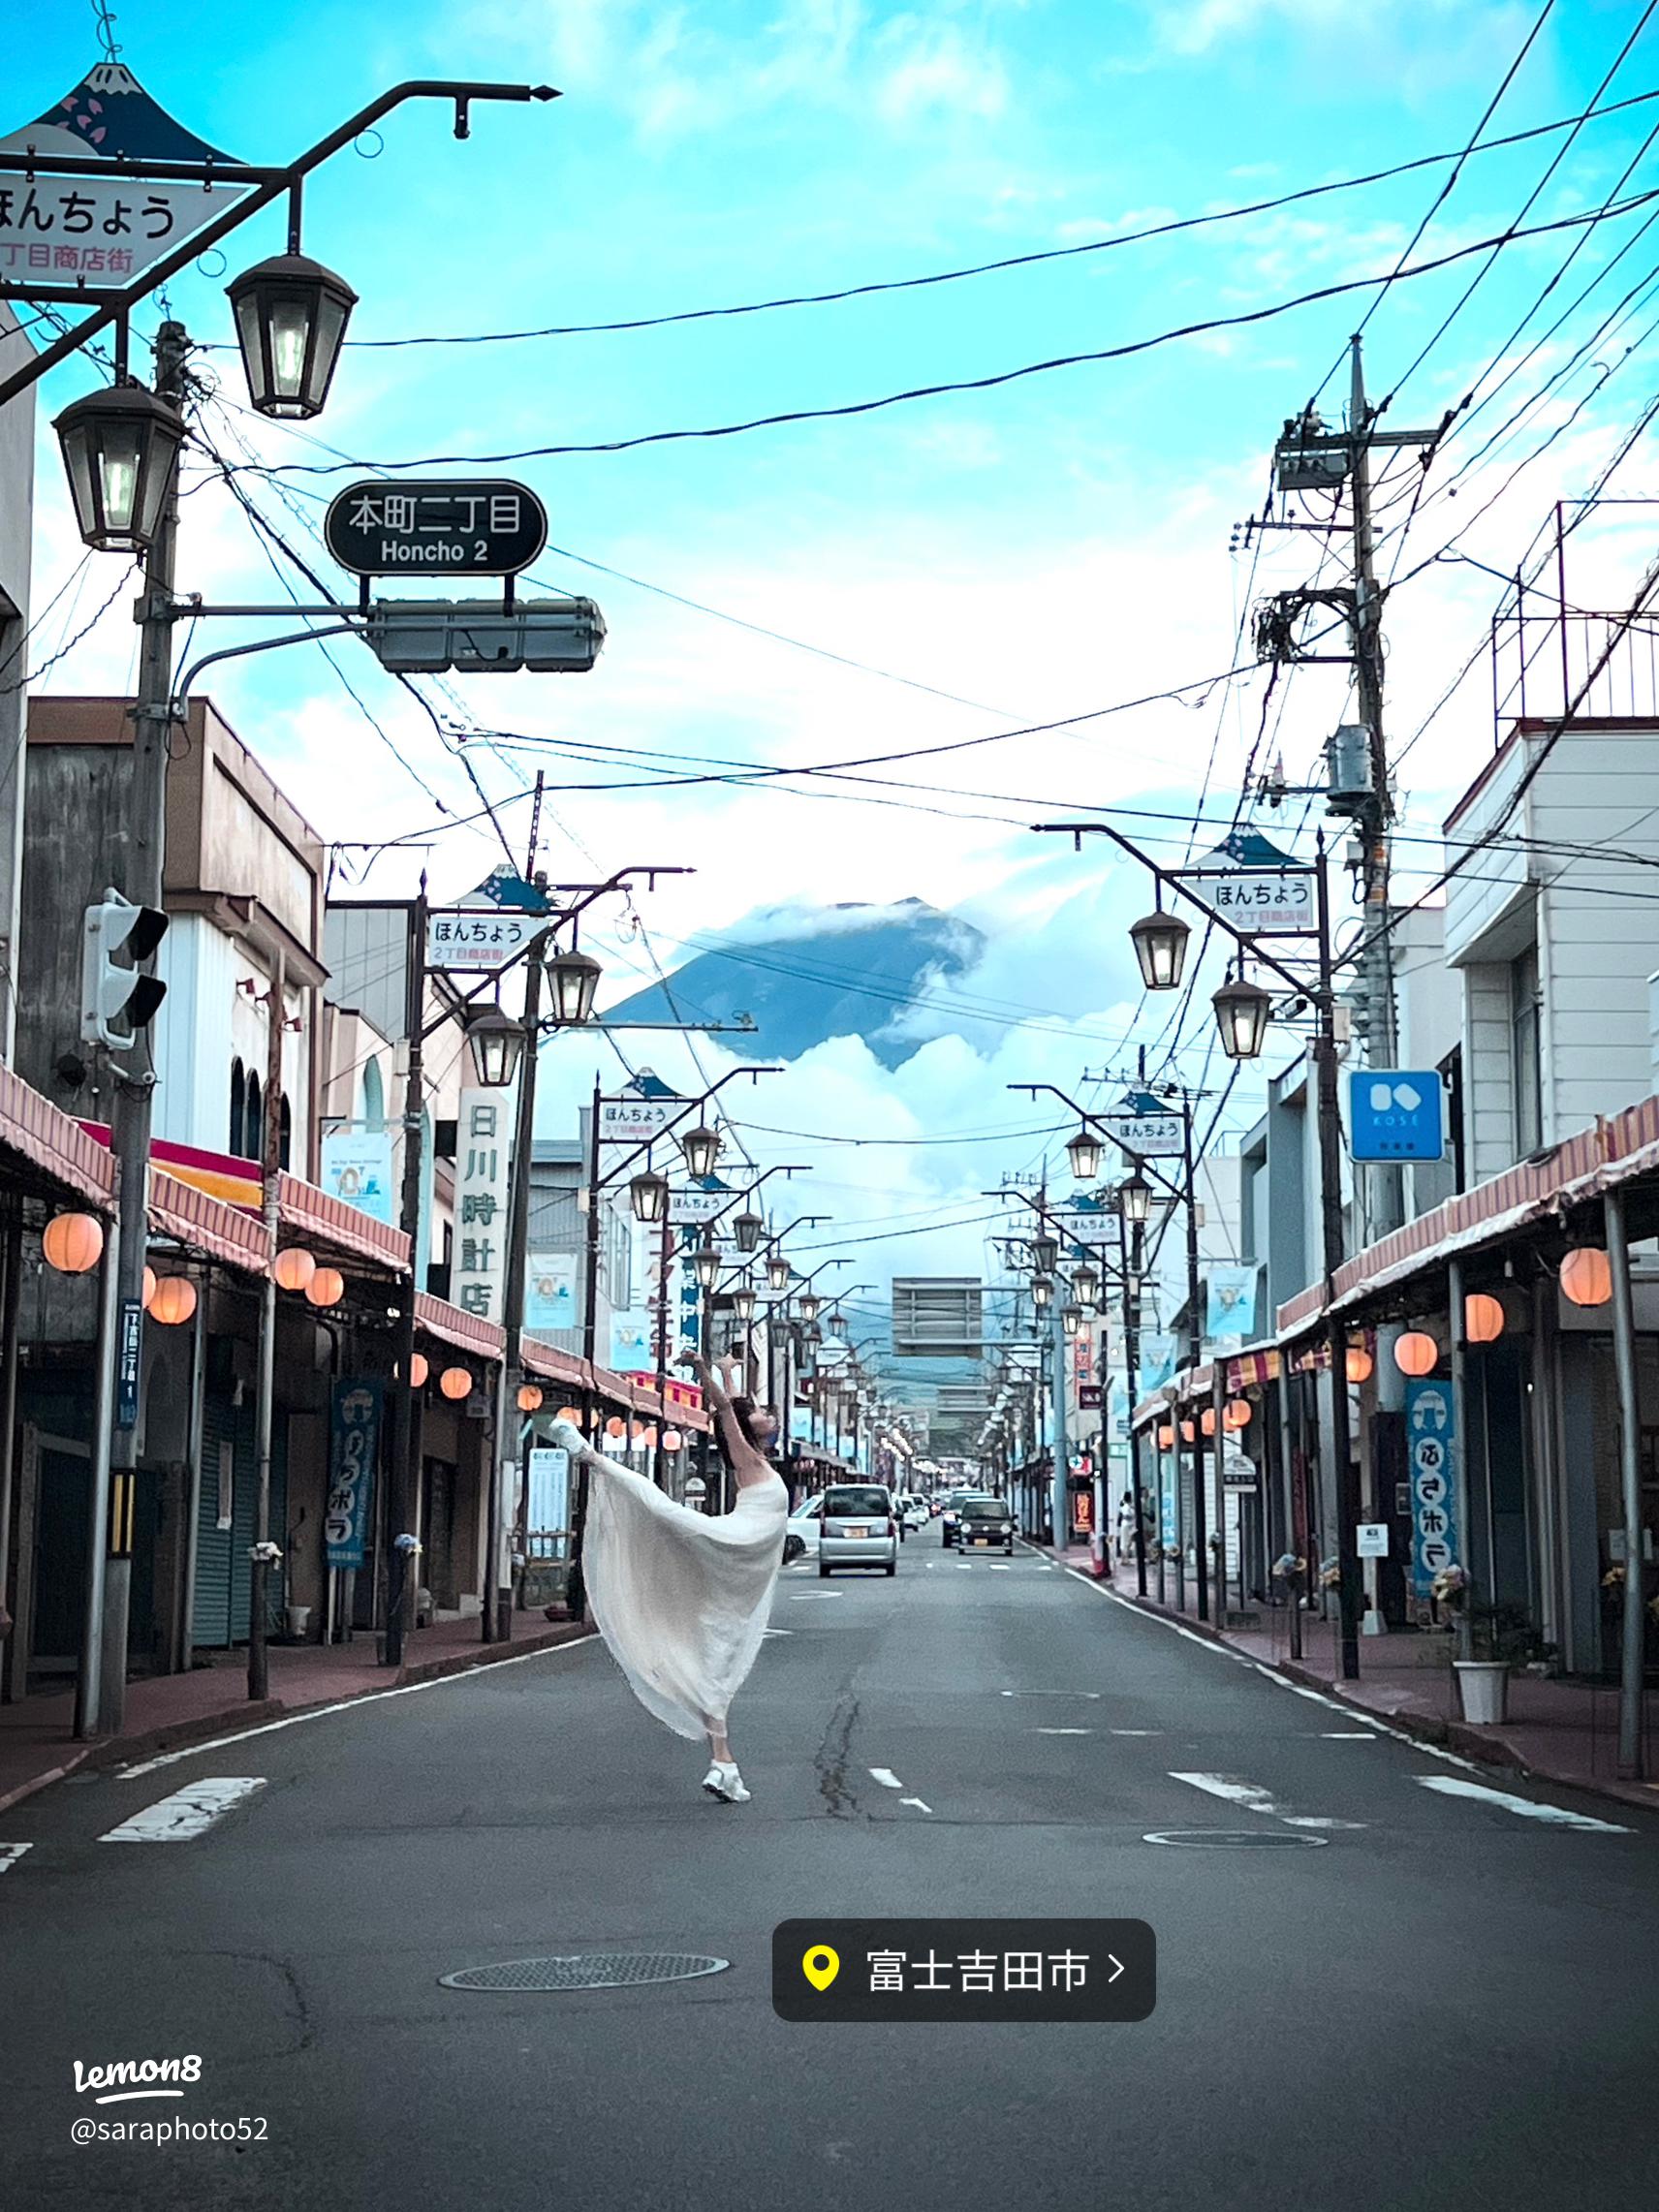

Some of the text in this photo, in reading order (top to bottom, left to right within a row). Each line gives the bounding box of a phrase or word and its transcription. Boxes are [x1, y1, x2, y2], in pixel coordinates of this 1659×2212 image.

[349, 494, 519, 535] 本町二丁目
[381, 540, 487, 562] Honcho 2
[1215, 883, 1308, 906] ほんちょう
[435, 921, 522, 943] ほんちょう
[606, 1106, 667, 1122] ほんちょう
[1119, 1122, 1178, 1137] ほんちょう
[459, 1105, 497, 1318] 日川時計店
[673, 1198, 720, 1209] ほんちょう
